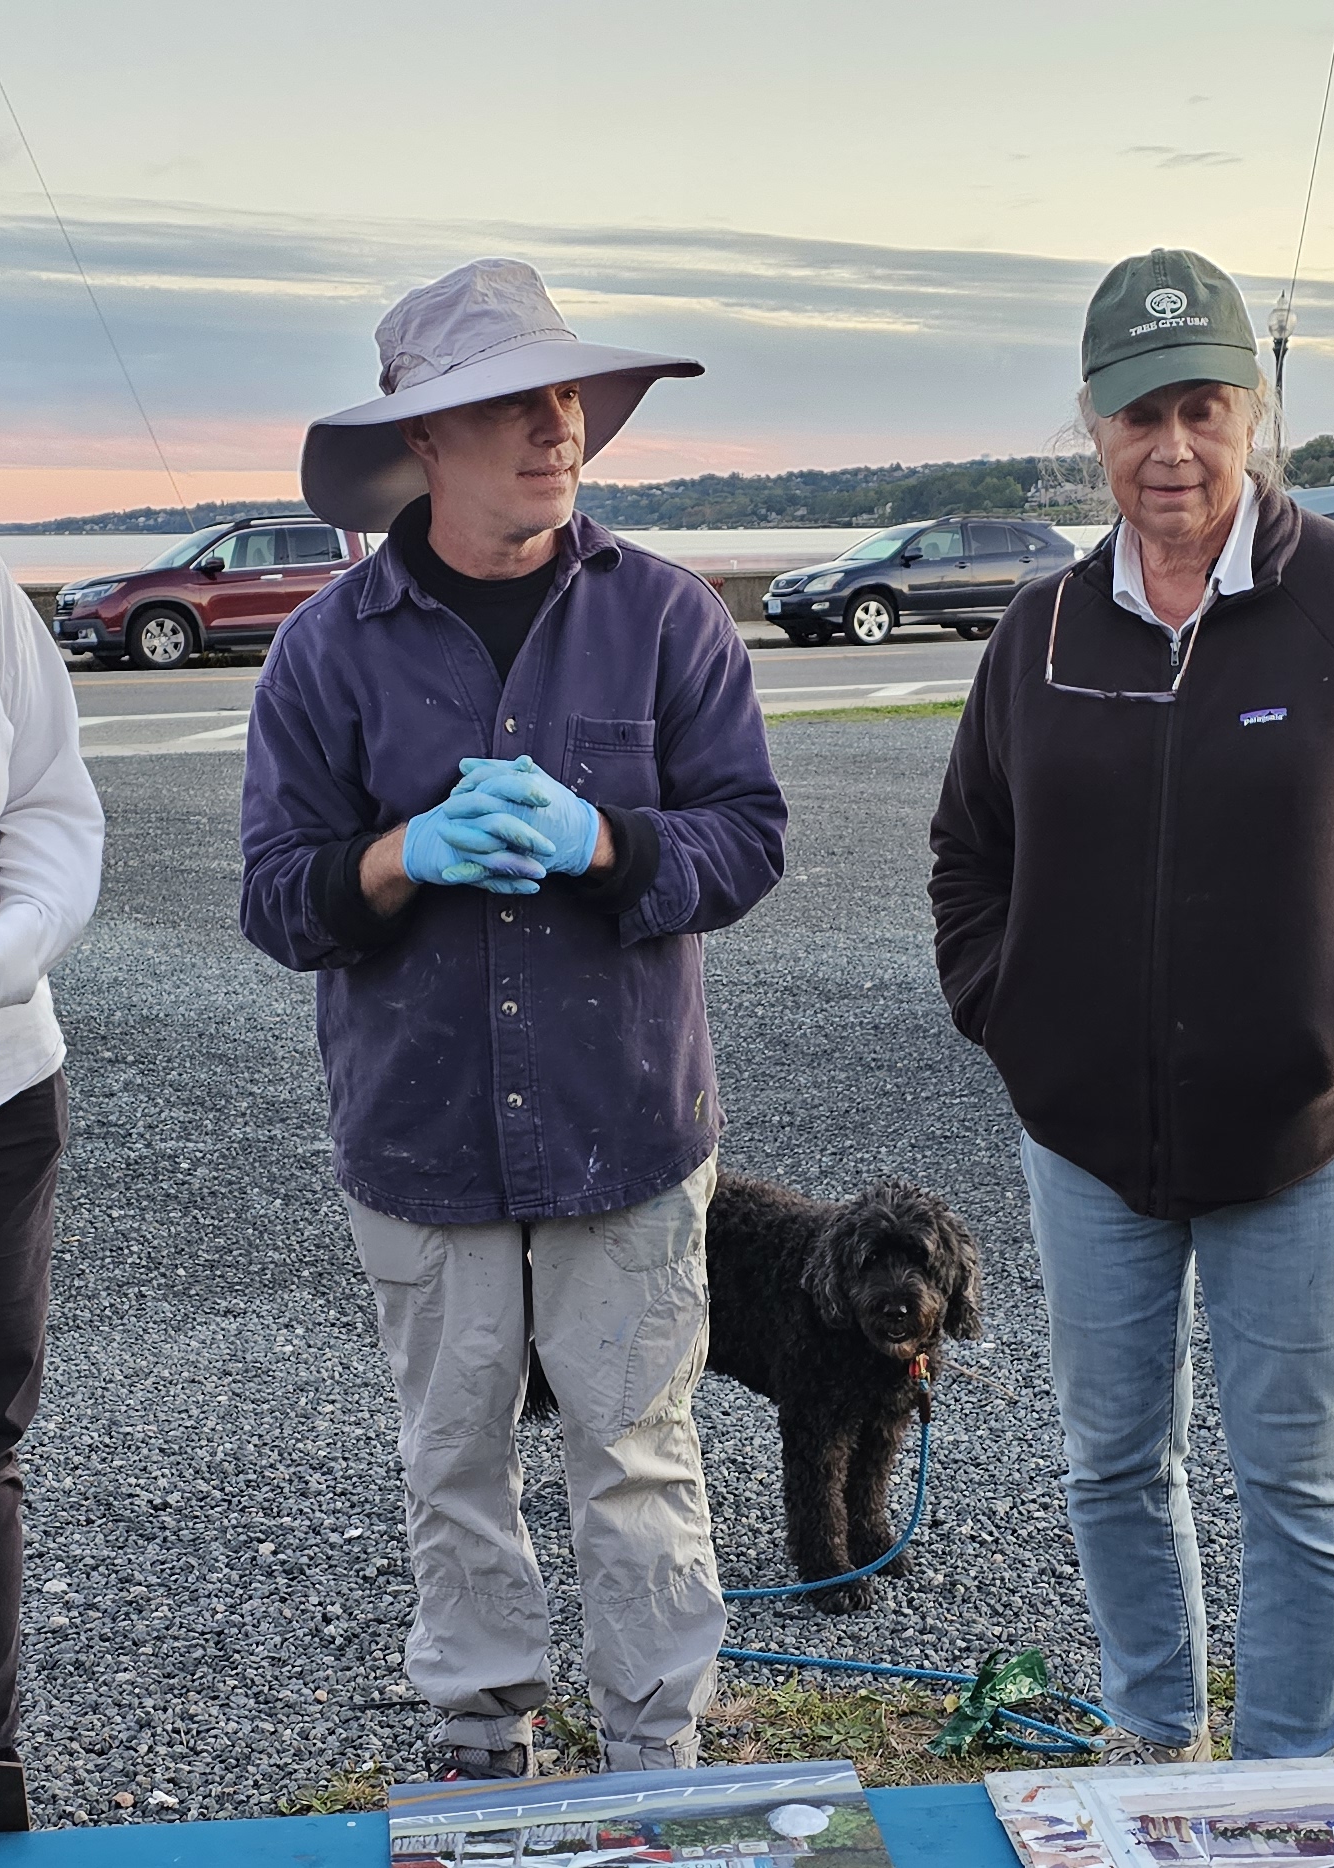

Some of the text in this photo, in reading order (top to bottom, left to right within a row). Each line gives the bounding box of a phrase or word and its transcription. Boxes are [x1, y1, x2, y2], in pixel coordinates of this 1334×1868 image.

[1129, 317, 1206, 337] TREE CITY USA
